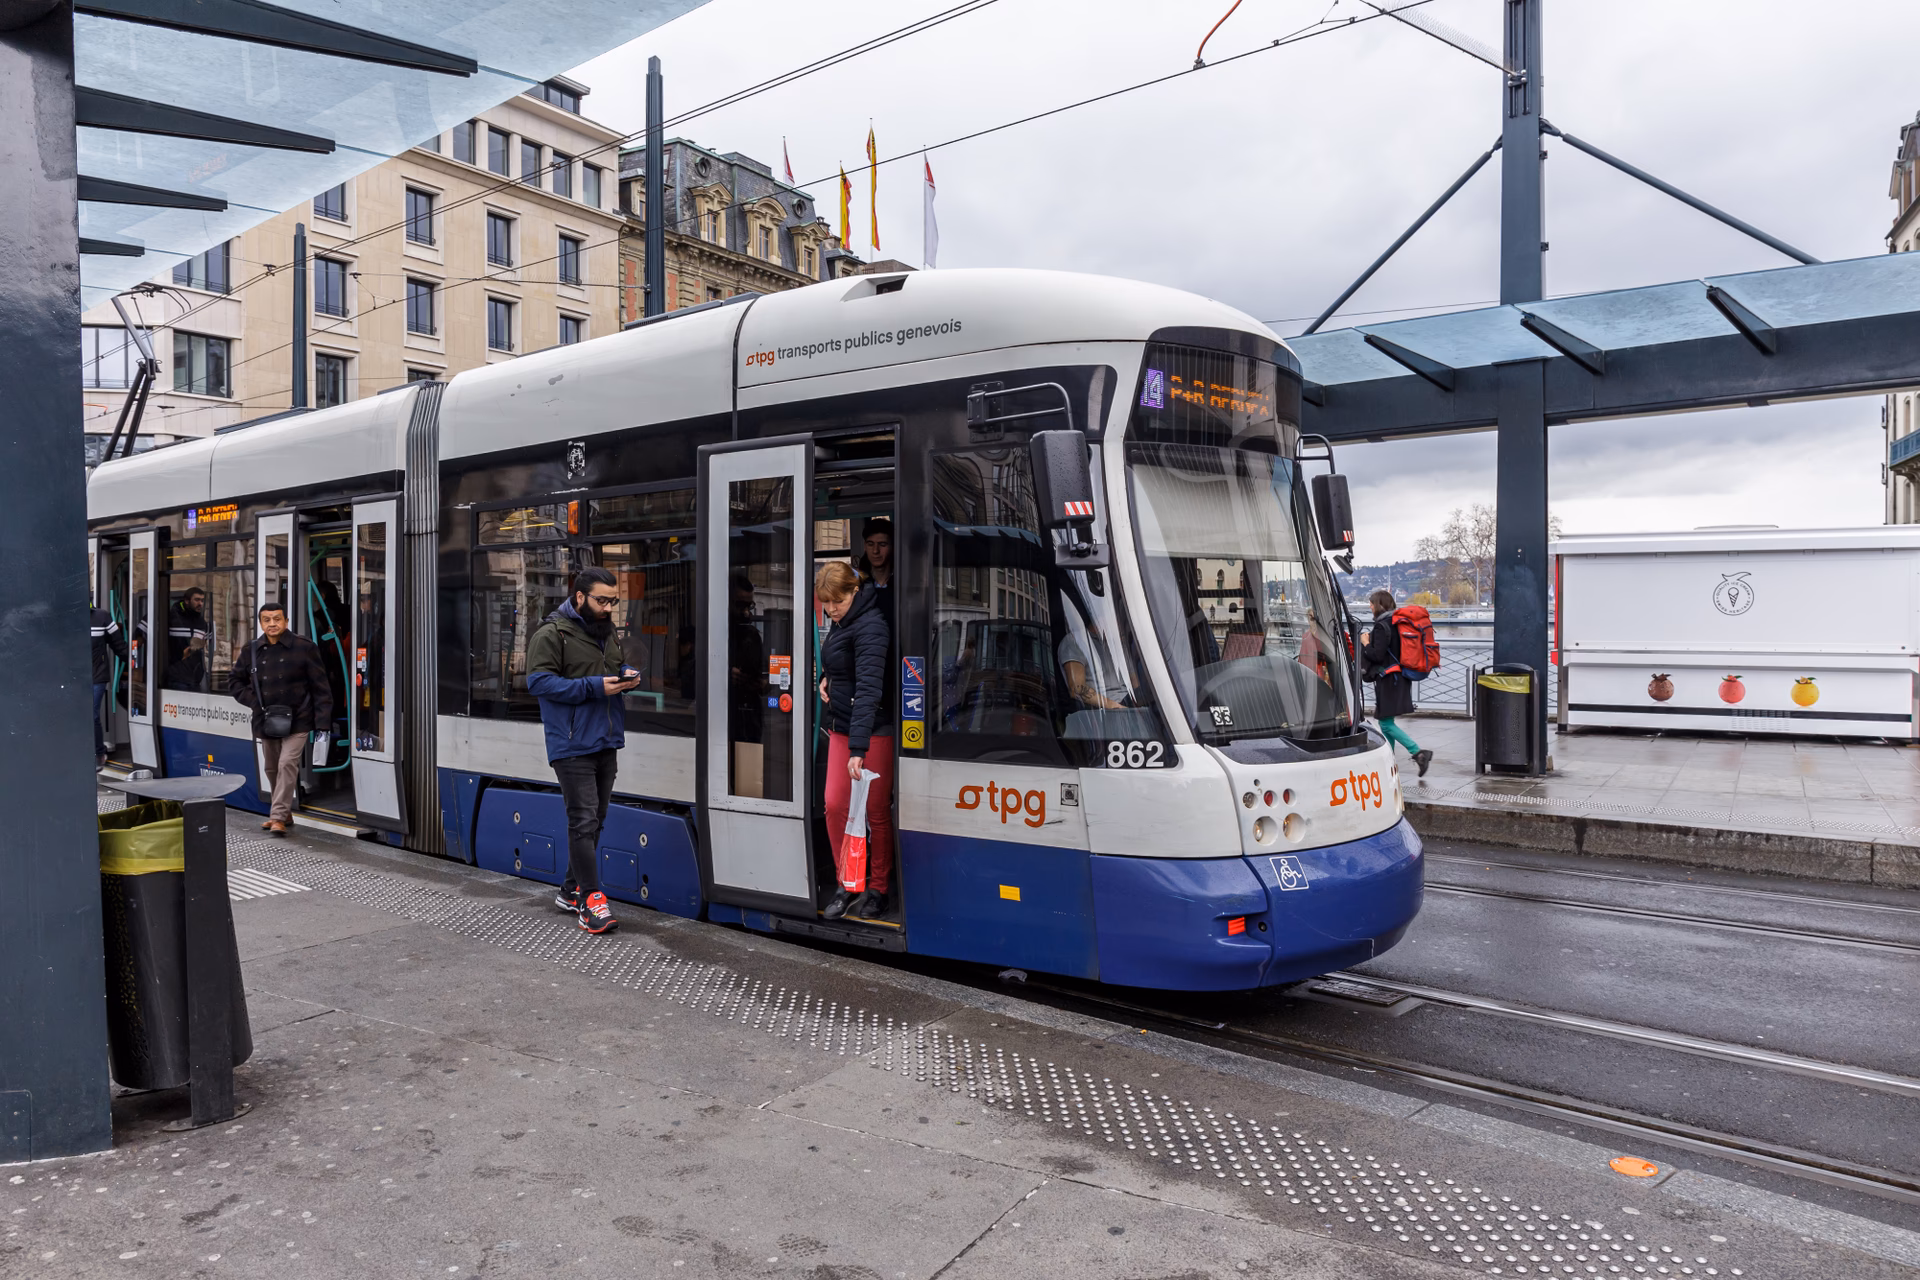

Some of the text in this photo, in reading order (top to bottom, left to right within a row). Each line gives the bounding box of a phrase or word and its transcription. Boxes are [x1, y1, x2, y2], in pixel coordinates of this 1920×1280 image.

[777, 337, 842, 360] transports
[844, 331, 893, 353] publics
[896, 318, 962, 345] genevois
[178, 704, 207, 720] transports
[207, 706, 229, 722] publics
[1107, 741, 1164, 768] 862
